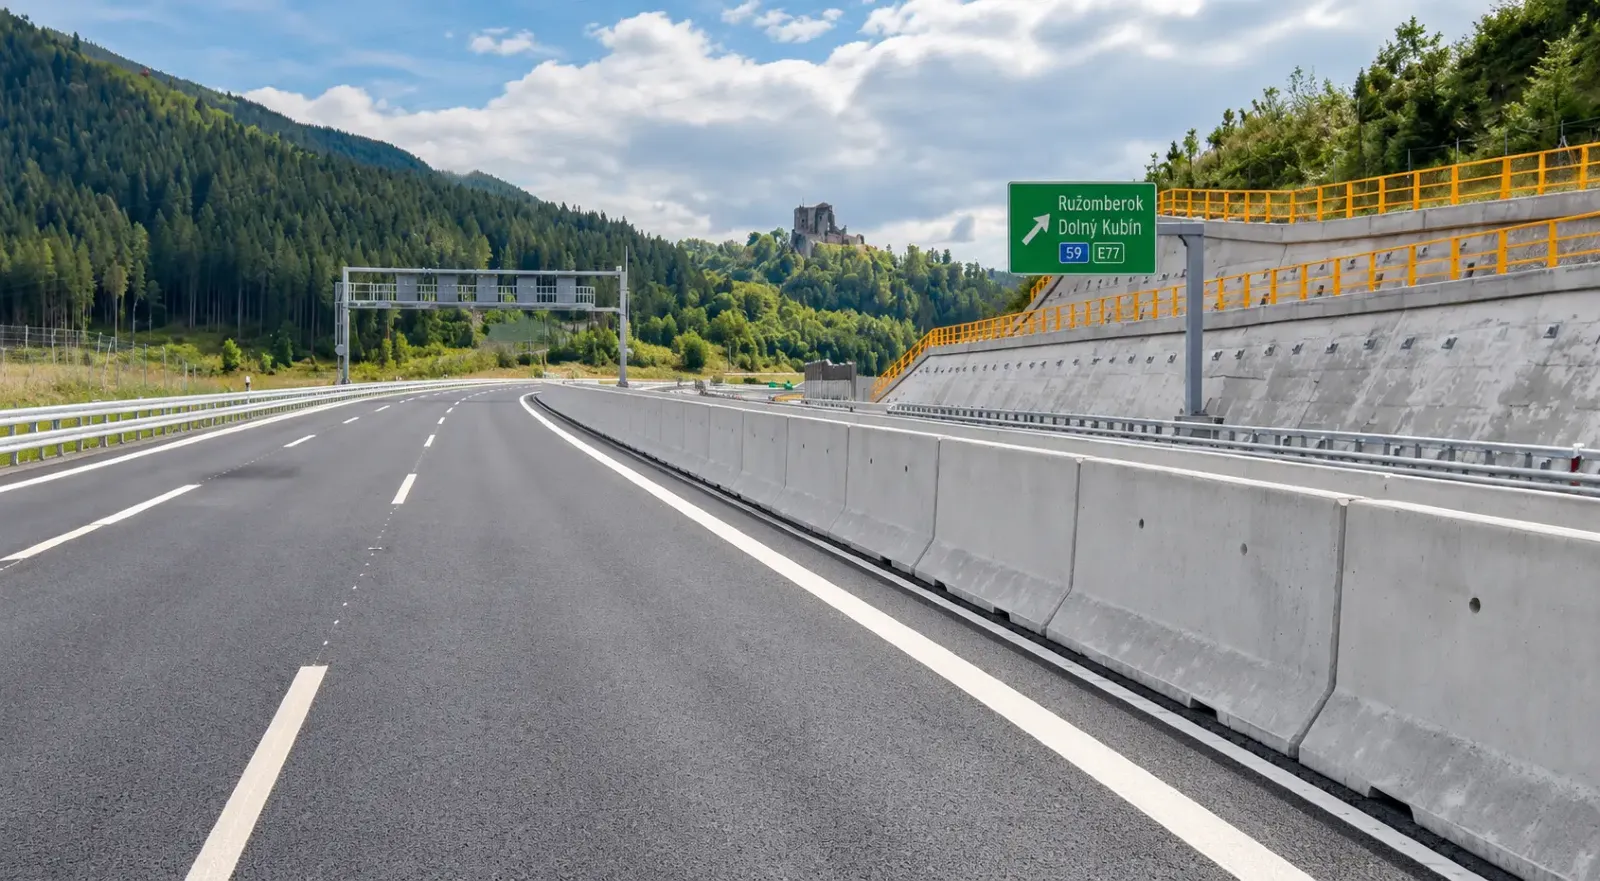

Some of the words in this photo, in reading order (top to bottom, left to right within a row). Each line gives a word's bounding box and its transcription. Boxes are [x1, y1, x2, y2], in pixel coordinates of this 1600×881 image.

[1058, 195, 1144, 211] Ružomberok
[1058, 218, 1097, 239] Dolný
[1102, 218, 1142, 235] Kubín
[1066, 246, 1082, 259] 59
[1098, 247, 1120, 259] E77
